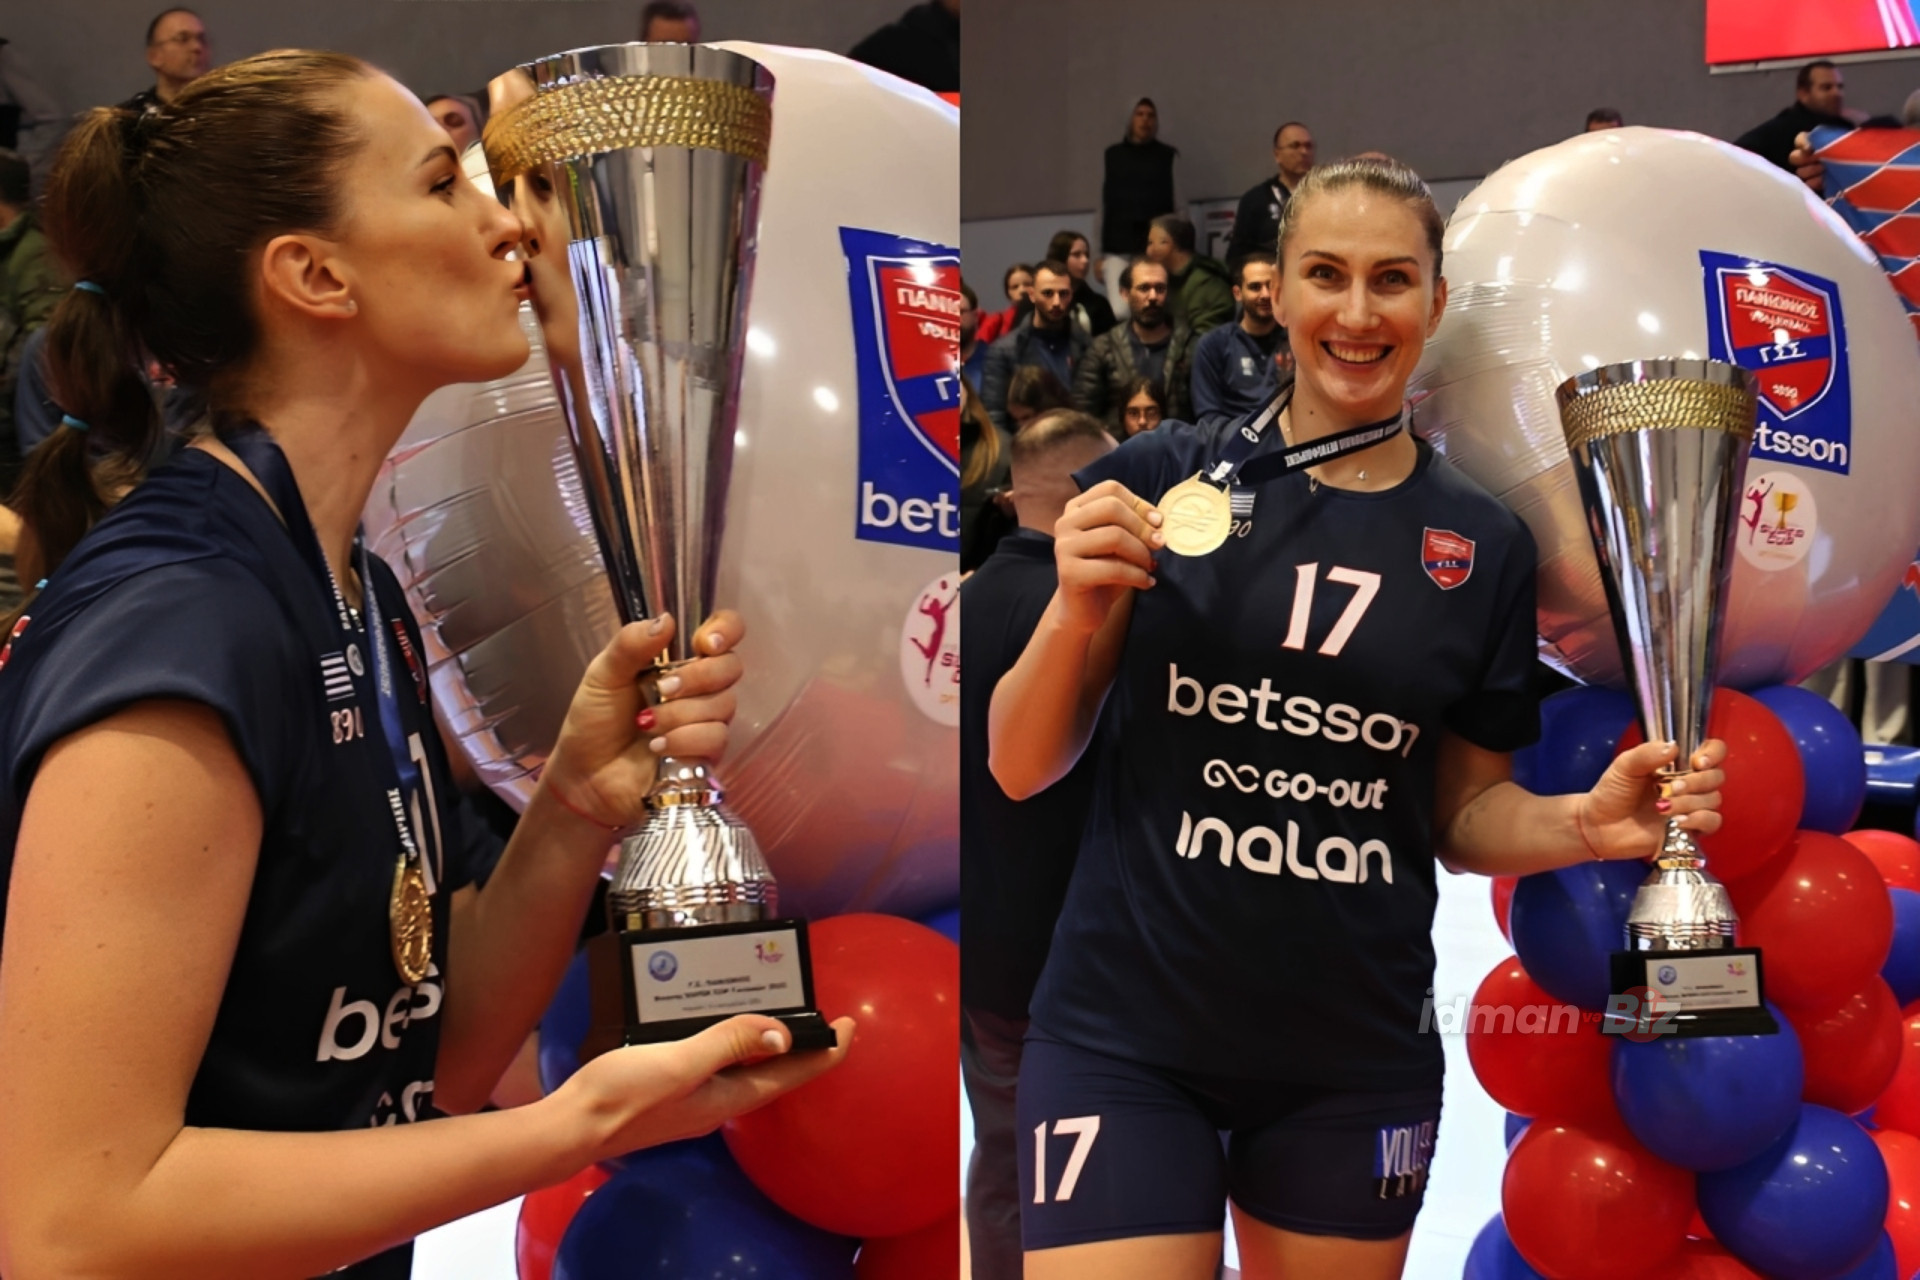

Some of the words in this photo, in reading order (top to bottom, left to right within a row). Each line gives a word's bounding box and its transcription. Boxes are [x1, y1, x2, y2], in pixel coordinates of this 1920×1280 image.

[1751, 421, 1848, 467] tsson
[861, 481, 960, 538] bet
[1280, 562, 1383, 657] 17
[1167, 662, 1421, 759] betsson
[1033, 1114, 1101, 1204] 17
